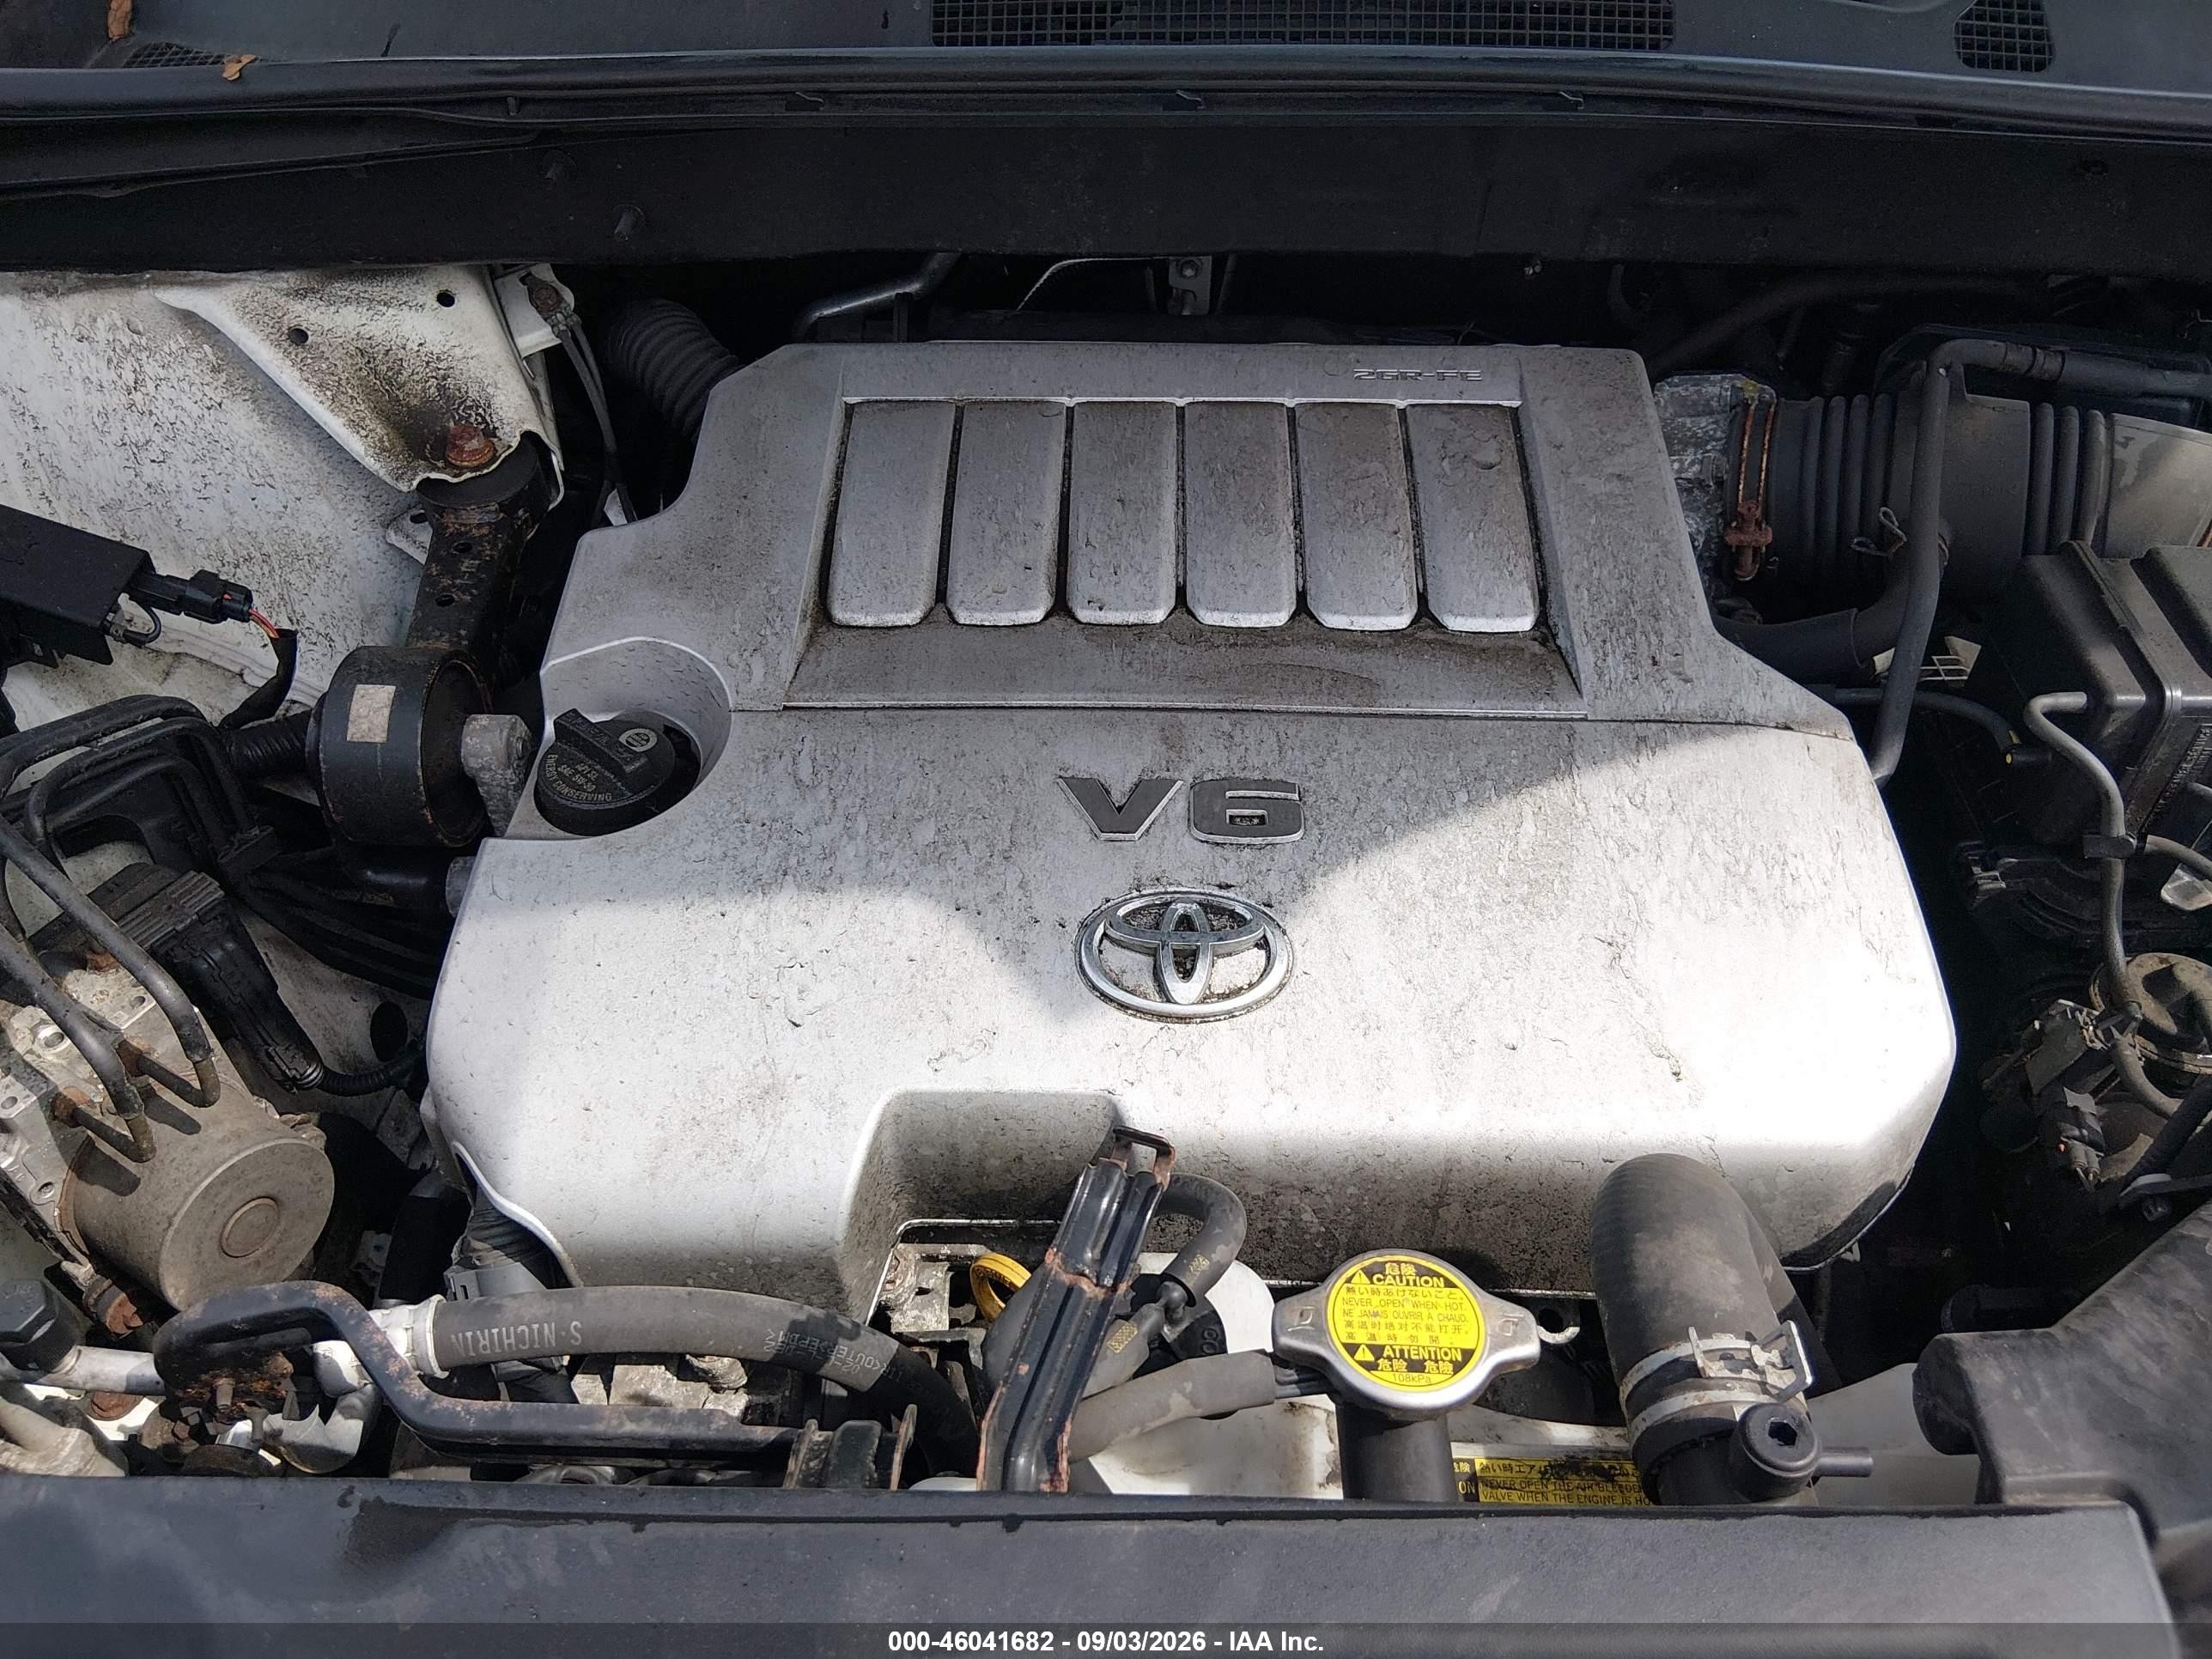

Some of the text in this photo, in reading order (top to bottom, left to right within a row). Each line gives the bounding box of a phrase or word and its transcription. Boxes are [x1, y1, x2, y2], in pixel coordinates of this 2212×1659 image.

[1352, 368, 1484, 382] 2GR-FE
[553, 781, 612, 801] CONSERVING
[1055, 775, 1306, 845] V6
[1373, 1273, 1445, 1288] CAUTION
[1342, 1297, 1373, 1307] NEVER
[1379, 1298, 1405, 1308] OPEN
[1411, 1300, 1438, 1310] WHEN
[1342, 1309, 1354, 1318] NE
[1359, 1310, 1389, 1319] JAMAIS
[1392, 1310, 1423, 1321] OUVRIR
[1383, 1345, 1462, 1361] ATTENTION
[1393, 1374, 1432, 1383] 108kPa
[1519, 1480, 1548, 1491] OPEN
[1553, 1481, 1574, 1492] THE
[1482, 1492, 1650, 1506] VALVE WHEN THE ENGINE IS HO
